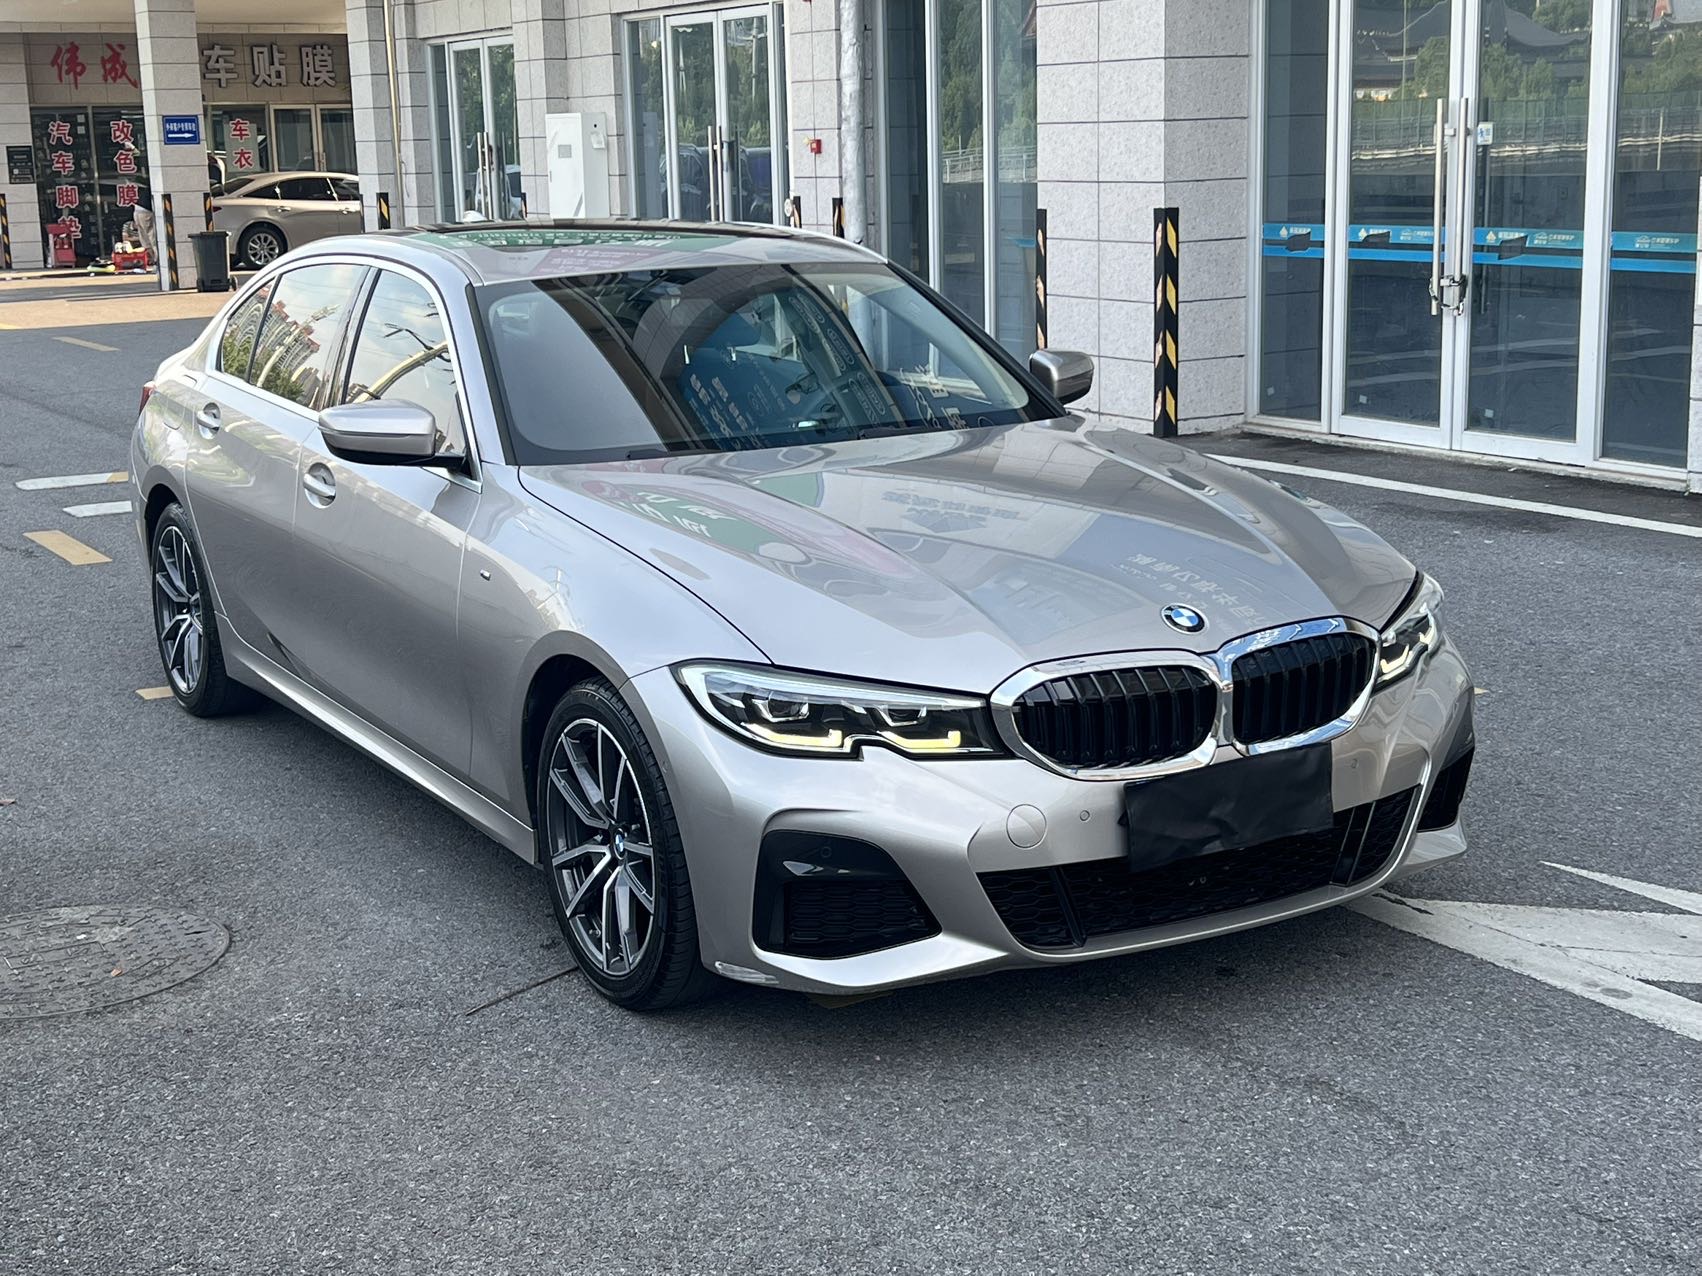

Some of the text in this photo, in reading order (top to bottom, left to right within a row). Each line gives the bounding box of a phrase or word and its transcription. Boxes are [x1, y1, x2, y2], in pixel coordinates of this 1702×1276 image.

[202, 43, 337, 88] 车贴膜
[110, 119, 139, 207] 改色膜
[229, 118, 253, 169] 车衣
